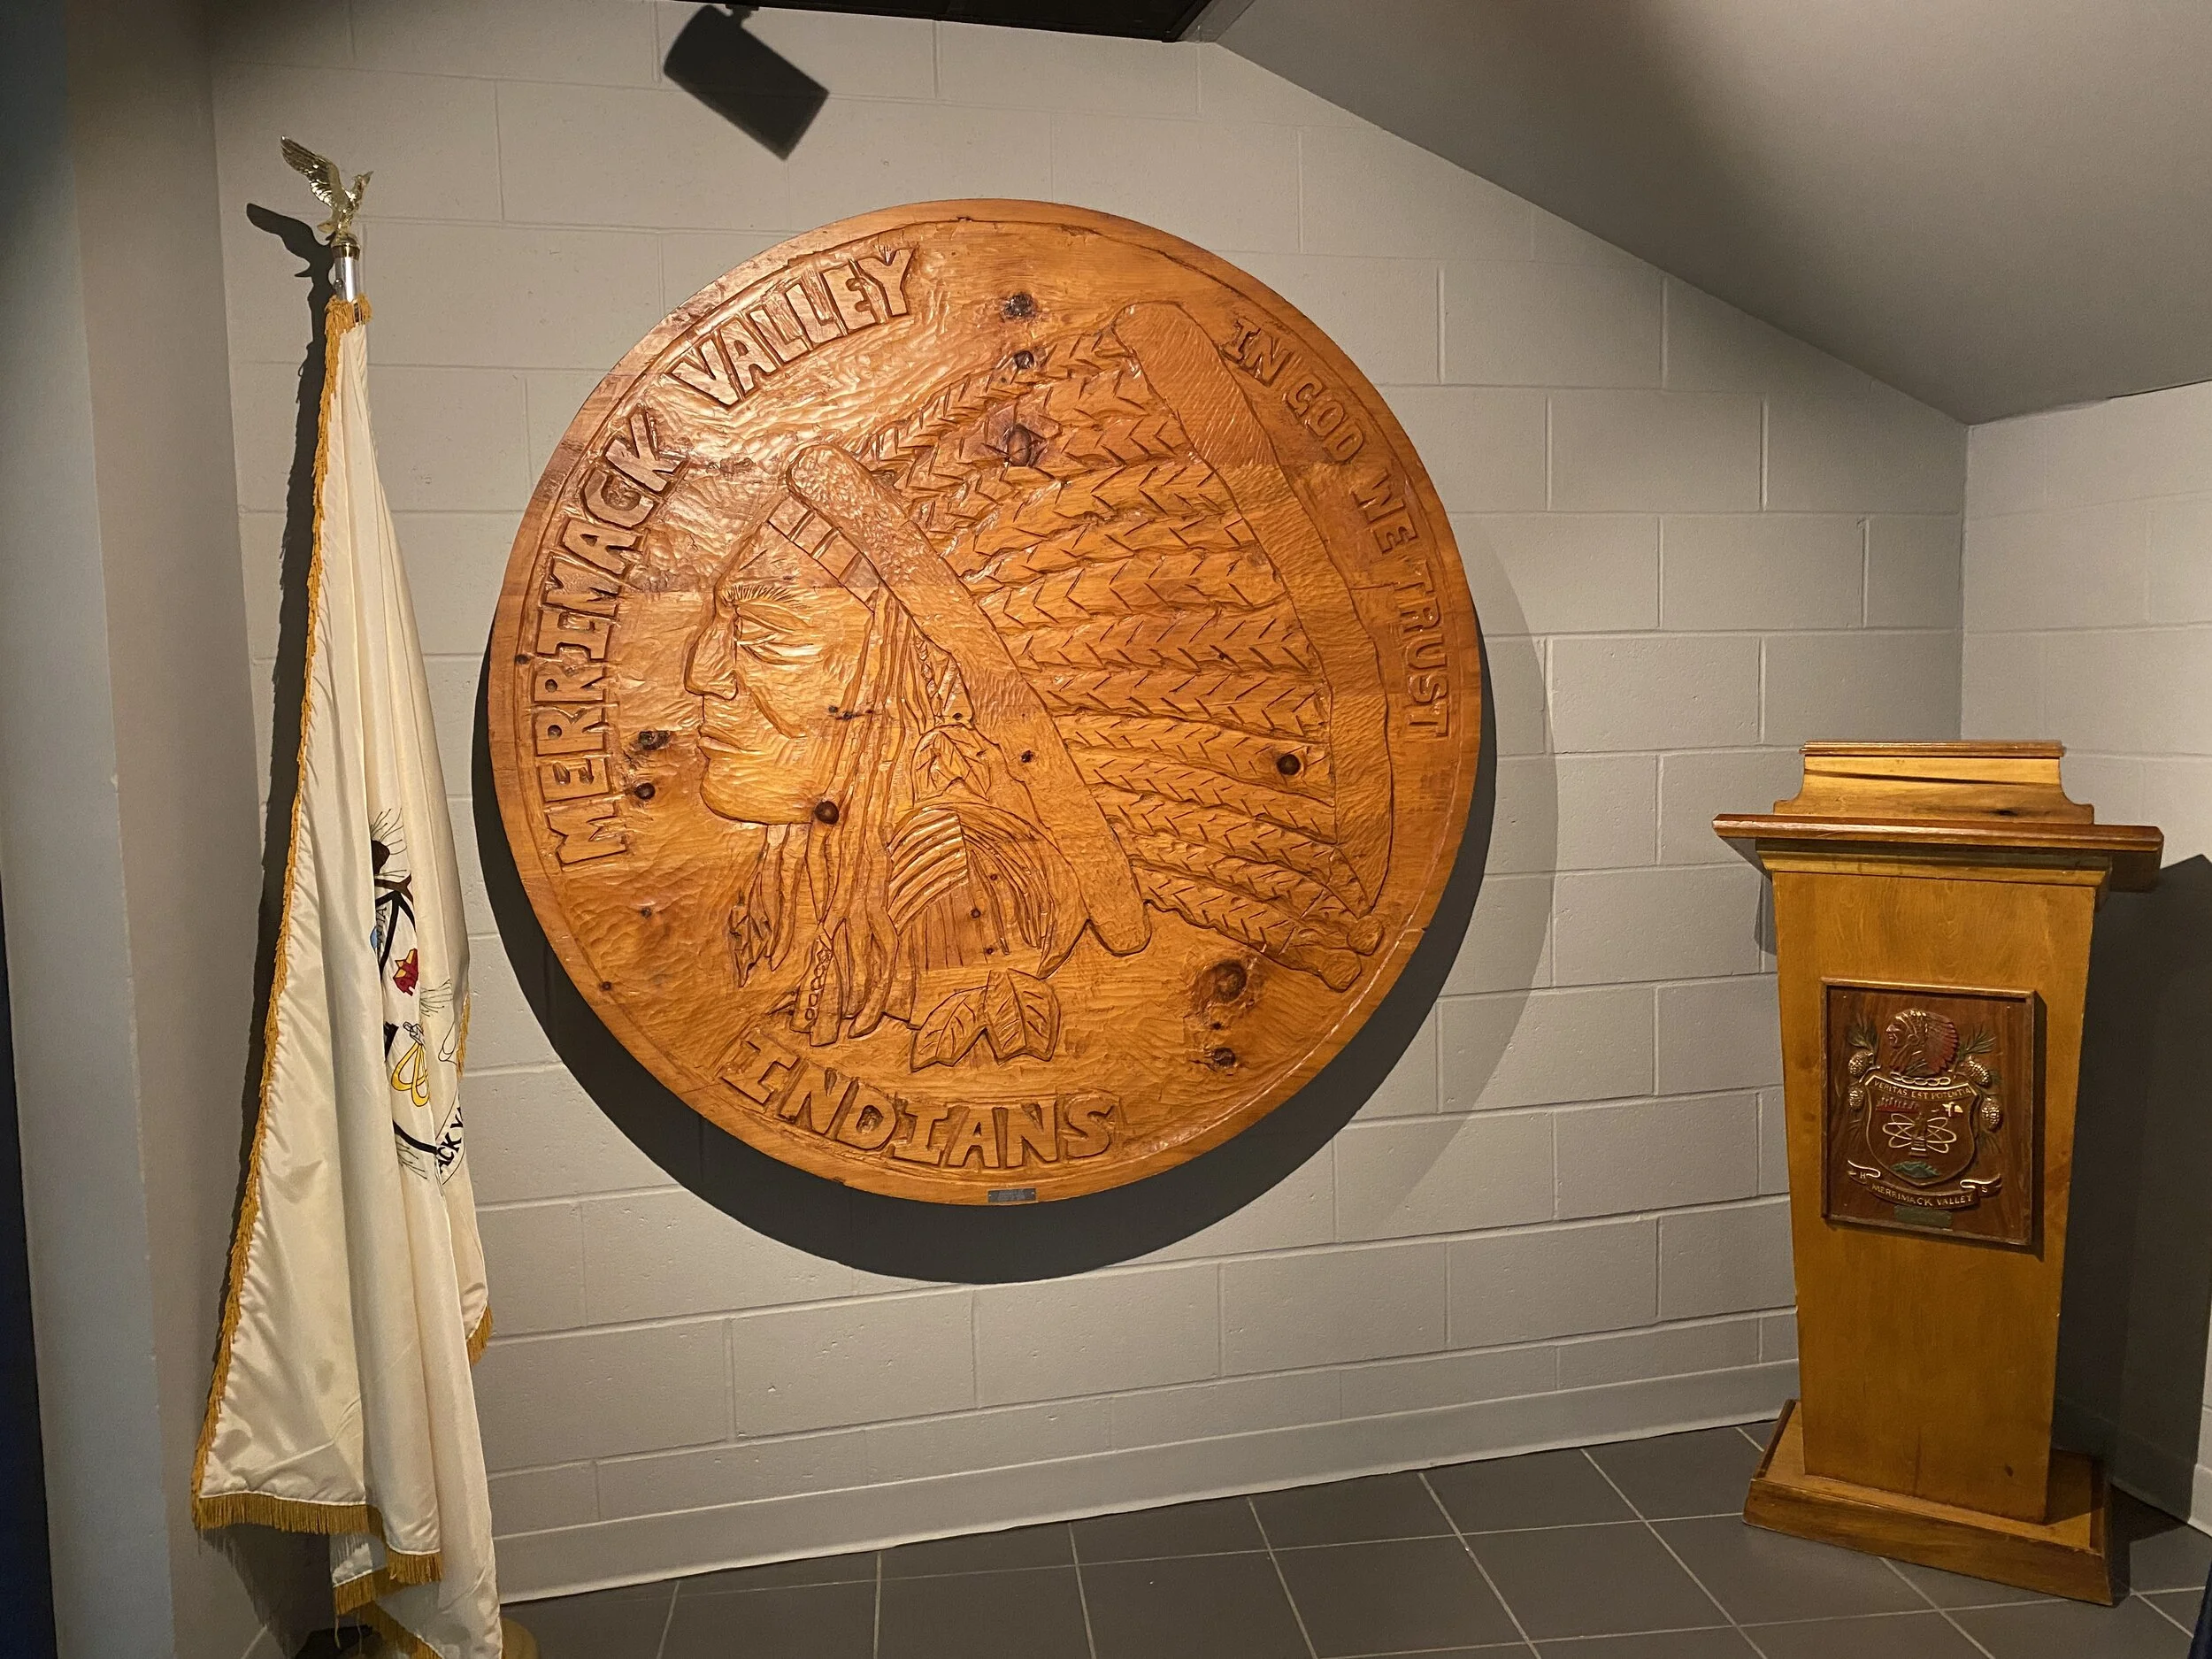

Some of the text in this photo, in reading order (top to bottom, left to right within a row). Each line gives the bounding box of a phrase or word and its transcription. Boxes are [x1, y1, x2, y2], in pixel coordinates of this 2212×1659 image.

[534, 249, 918, 872] MERRIMACK VALLEY
[1221, 317, 1450, 740] IN GOD WE TRUST
[720, 1040, 1121, 1169] INDIANS
[1874, 1080, 1971, 1100] VERITAS EST POTENTIA
[1871, 1182, 1972, 1207] MERRIMACK VALLEY
